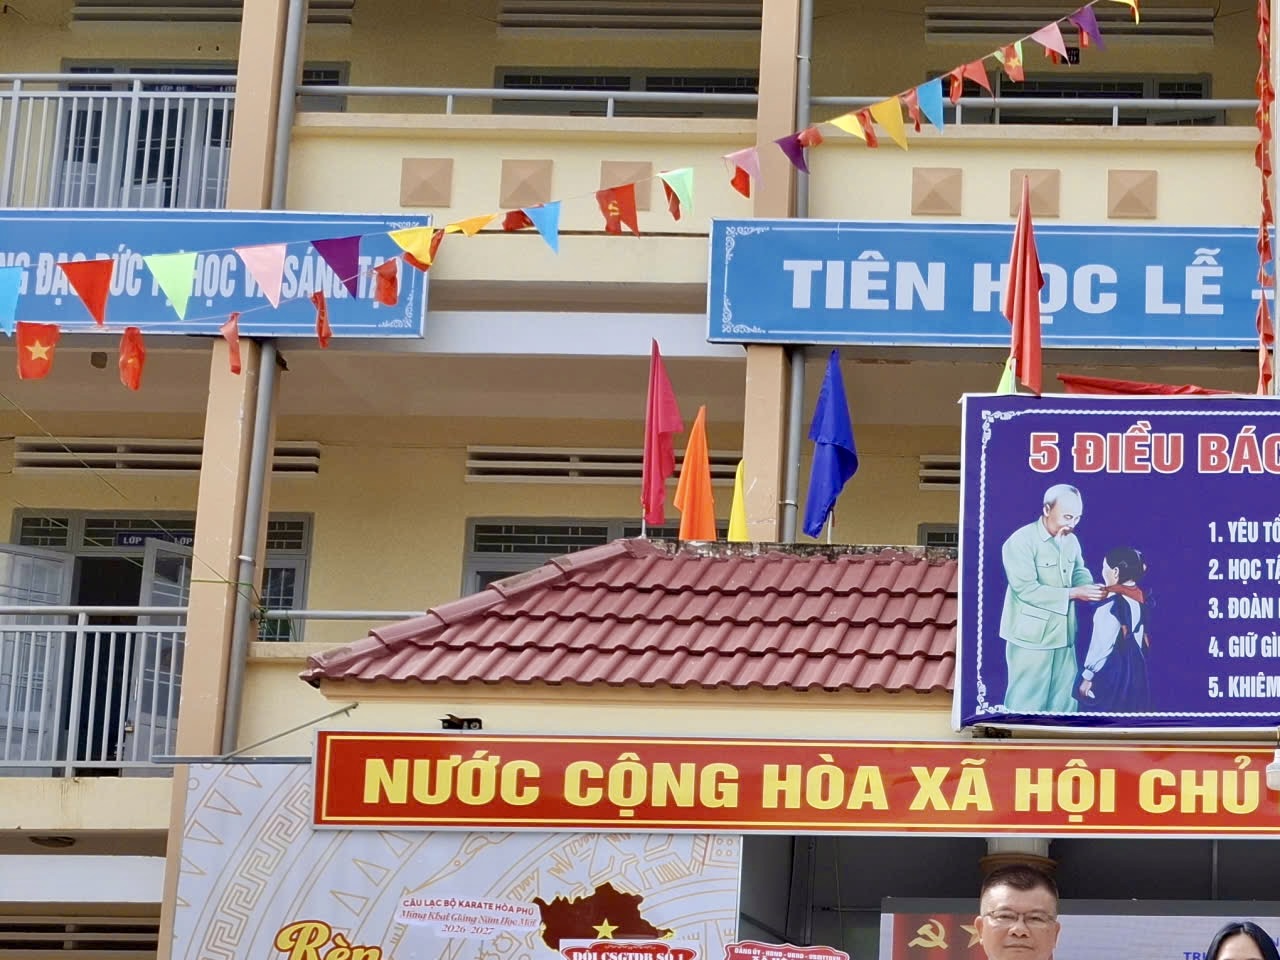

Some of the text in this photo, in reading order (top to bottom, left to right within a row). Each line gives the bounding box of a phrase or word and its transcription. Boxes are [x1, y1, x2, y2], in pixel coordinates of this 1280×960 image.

[95, 244, 143, 296] ỨC
[783, 250, 946, 312] TIÊN
[1144, 248, 1224, 315] LỄ
[1028, 431, 1060, 473] 5
[1073, 420, 1185, 474] ĐIỀU
[1208, 523, 1223, 542] 1.
[1228, 518, 1259, 542] YÊU
[1208, 559, 1223, 580] 2.
[1228, 559, 1262, 584] HỌC
[1208, 598, 1224, 619] 3.
[1228, 593, 1273, 619] ĐOÀN
[1208, 636, 1224, 658] 4.
[1228, 631, 1259, 658] GIỮ
[1208, 677, 1224, 699] 5.
[362, 749, 540, 807] NƯỚC
[563, 753, 739, 818] CỘNG
[762, 753, 890, 812] HÒA
[908, 758, 994, 812] XÃ
[1014, 760, 1116, 823] HỘI
[1138, 755, 1260, 816] CHỦ
[443, 898, 457, 910] BỘ
[458, 901, 494, 910] KARATE
